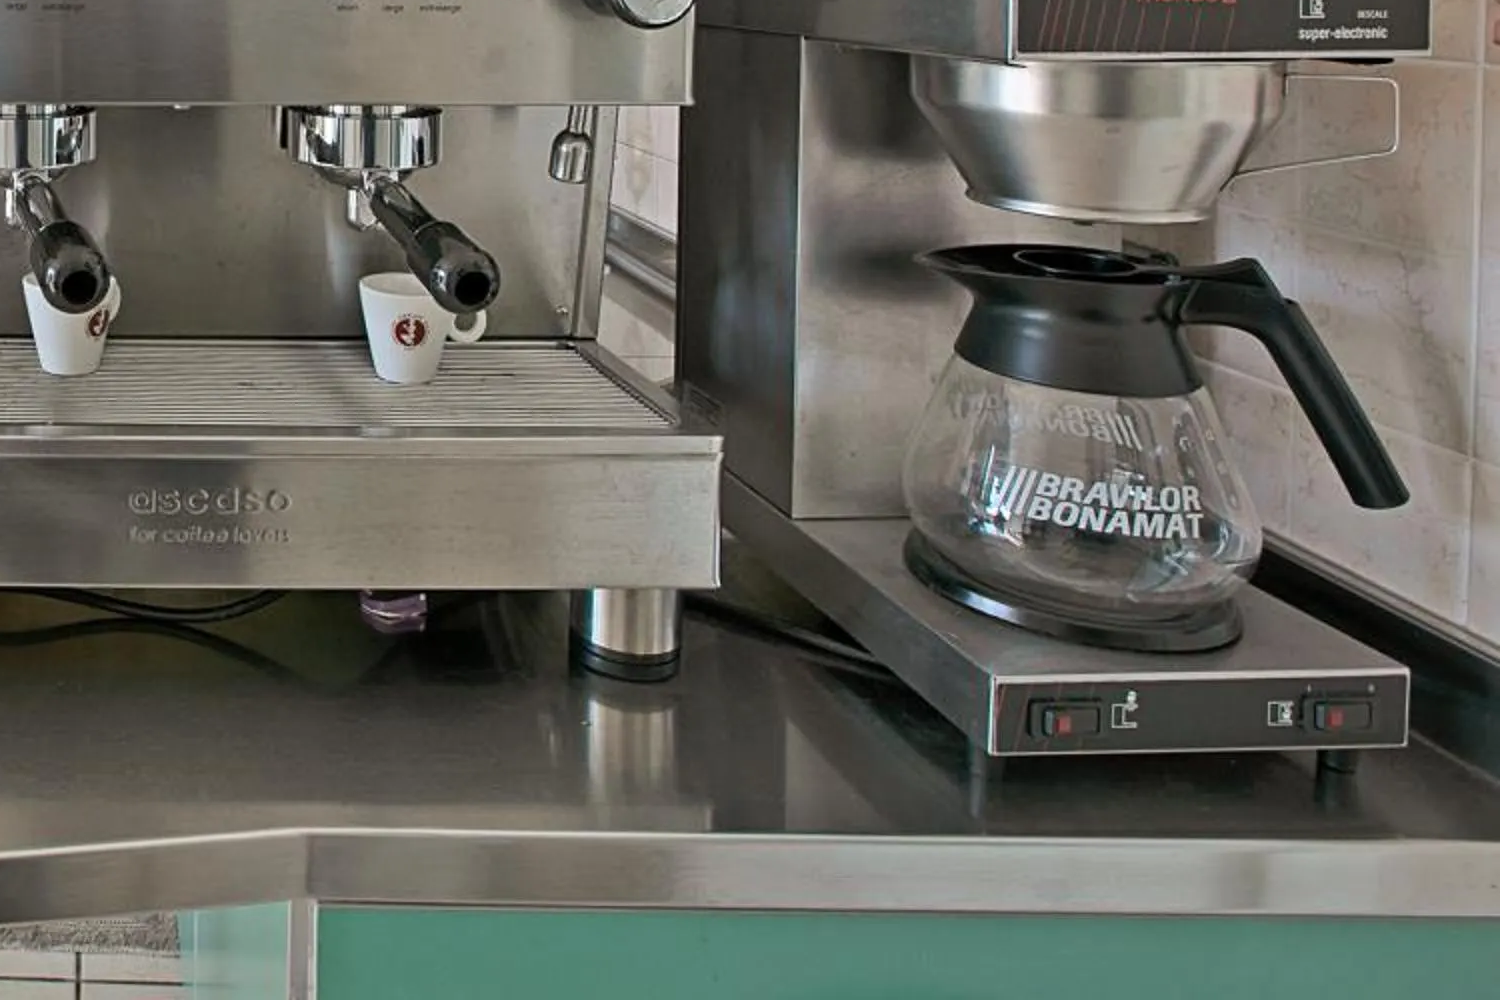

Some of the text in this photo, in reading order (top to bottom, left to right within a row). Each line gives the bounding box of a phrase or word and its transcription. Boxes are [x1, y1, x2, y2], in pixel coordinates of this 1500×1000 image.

[1036, 471, 1202, 513] BRAVILOR
[129, 524, 157, 543] for
[1028, 495, 1204, 540] BONAMAT
